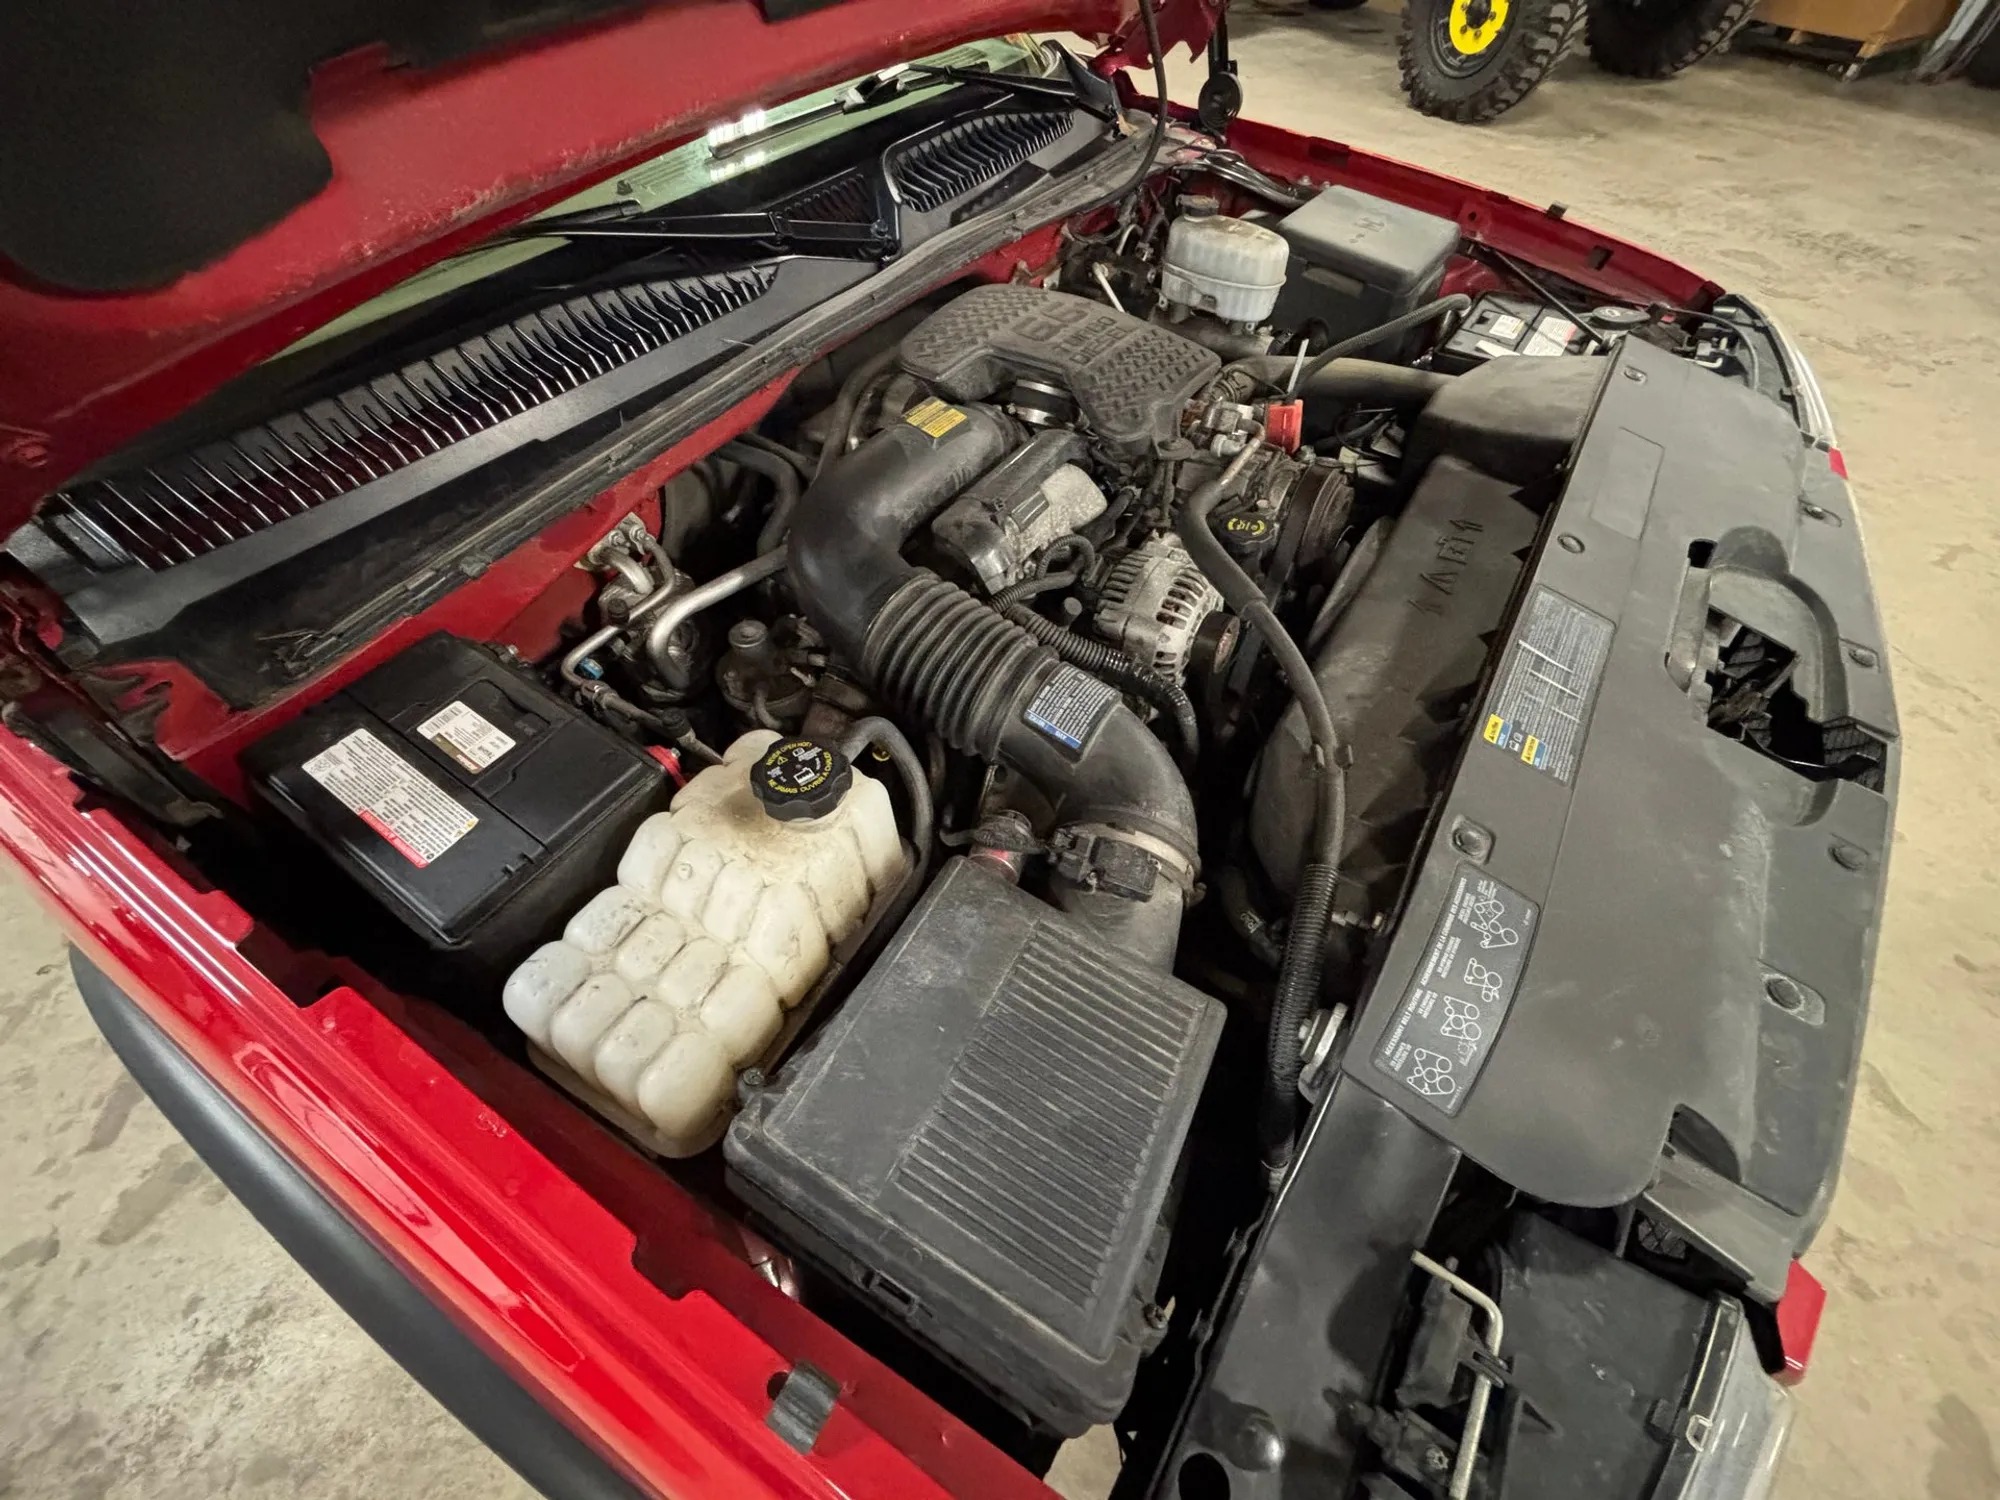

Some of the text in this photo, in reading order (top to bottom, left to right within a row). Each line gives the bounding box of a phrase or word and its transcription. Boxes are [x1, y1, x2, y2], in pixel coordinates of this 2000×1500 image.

[1052, 315, 1117, 352] TURBO
[1069, 326, 1139, 366] DIESEL
[780, 743, 797, 752] OPEN
[800, 776, 826, 793] OUVRIR
[1384, 1024, 1405, 1056] ACCESSORY
[1400, 1011, 1411, 1026] BELT
[1407, 988, 1424, 1013] ROUTING
